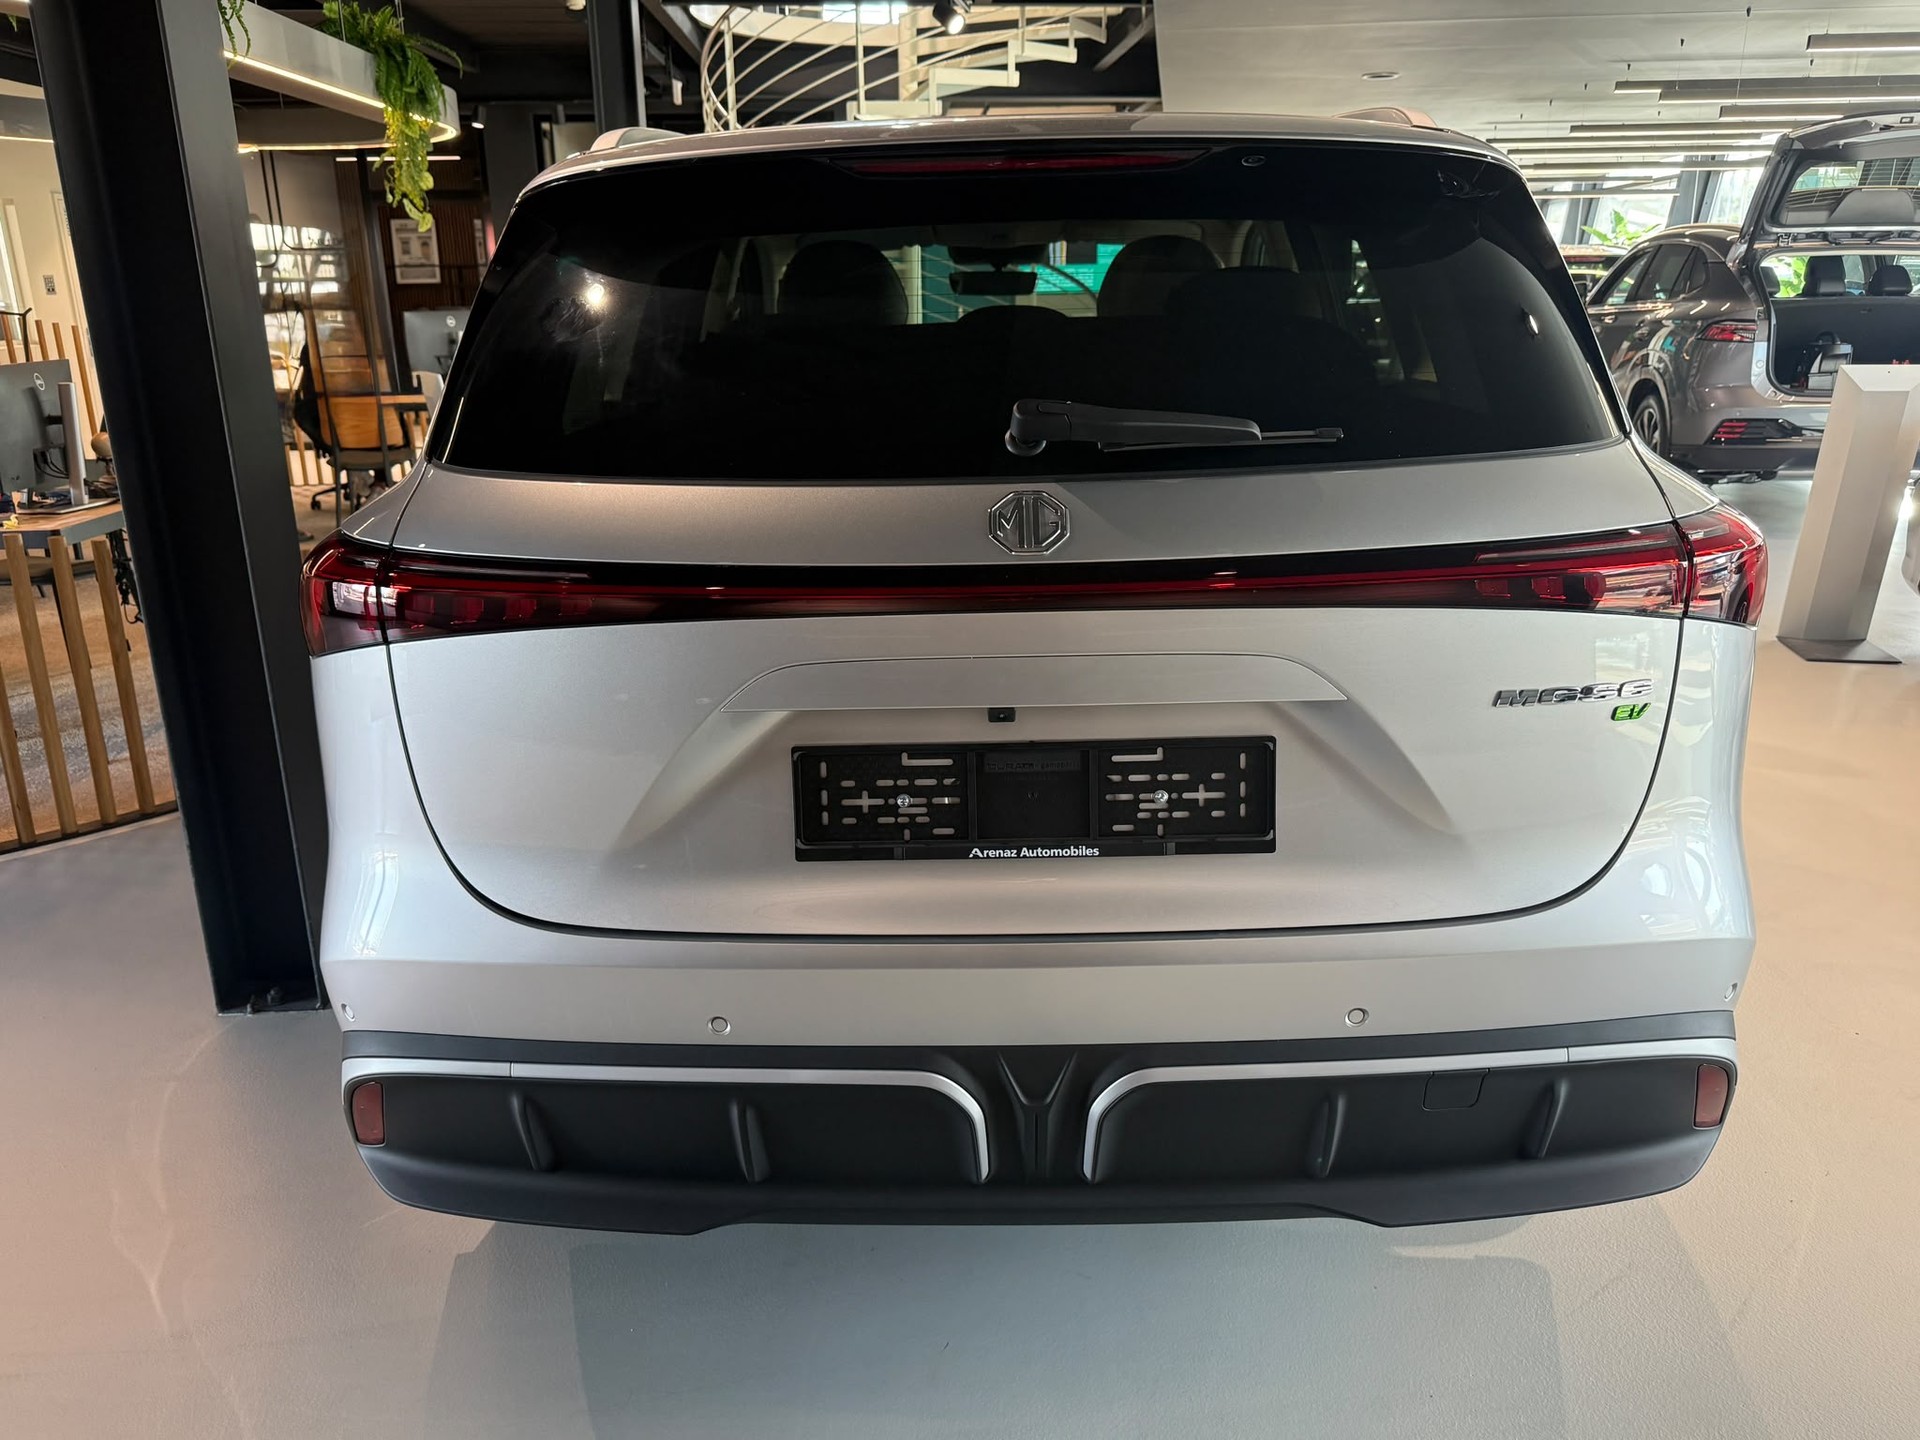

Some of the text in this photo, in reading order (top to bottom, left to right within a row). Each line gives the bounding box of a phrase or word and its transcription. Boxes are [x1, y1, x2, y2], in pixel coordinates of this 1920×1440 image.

[993, 493, 1065, 552] MG
[1611, 703, 1652, 721] EV
[968, 845, 1100, 858] Arenaz Automobiles
